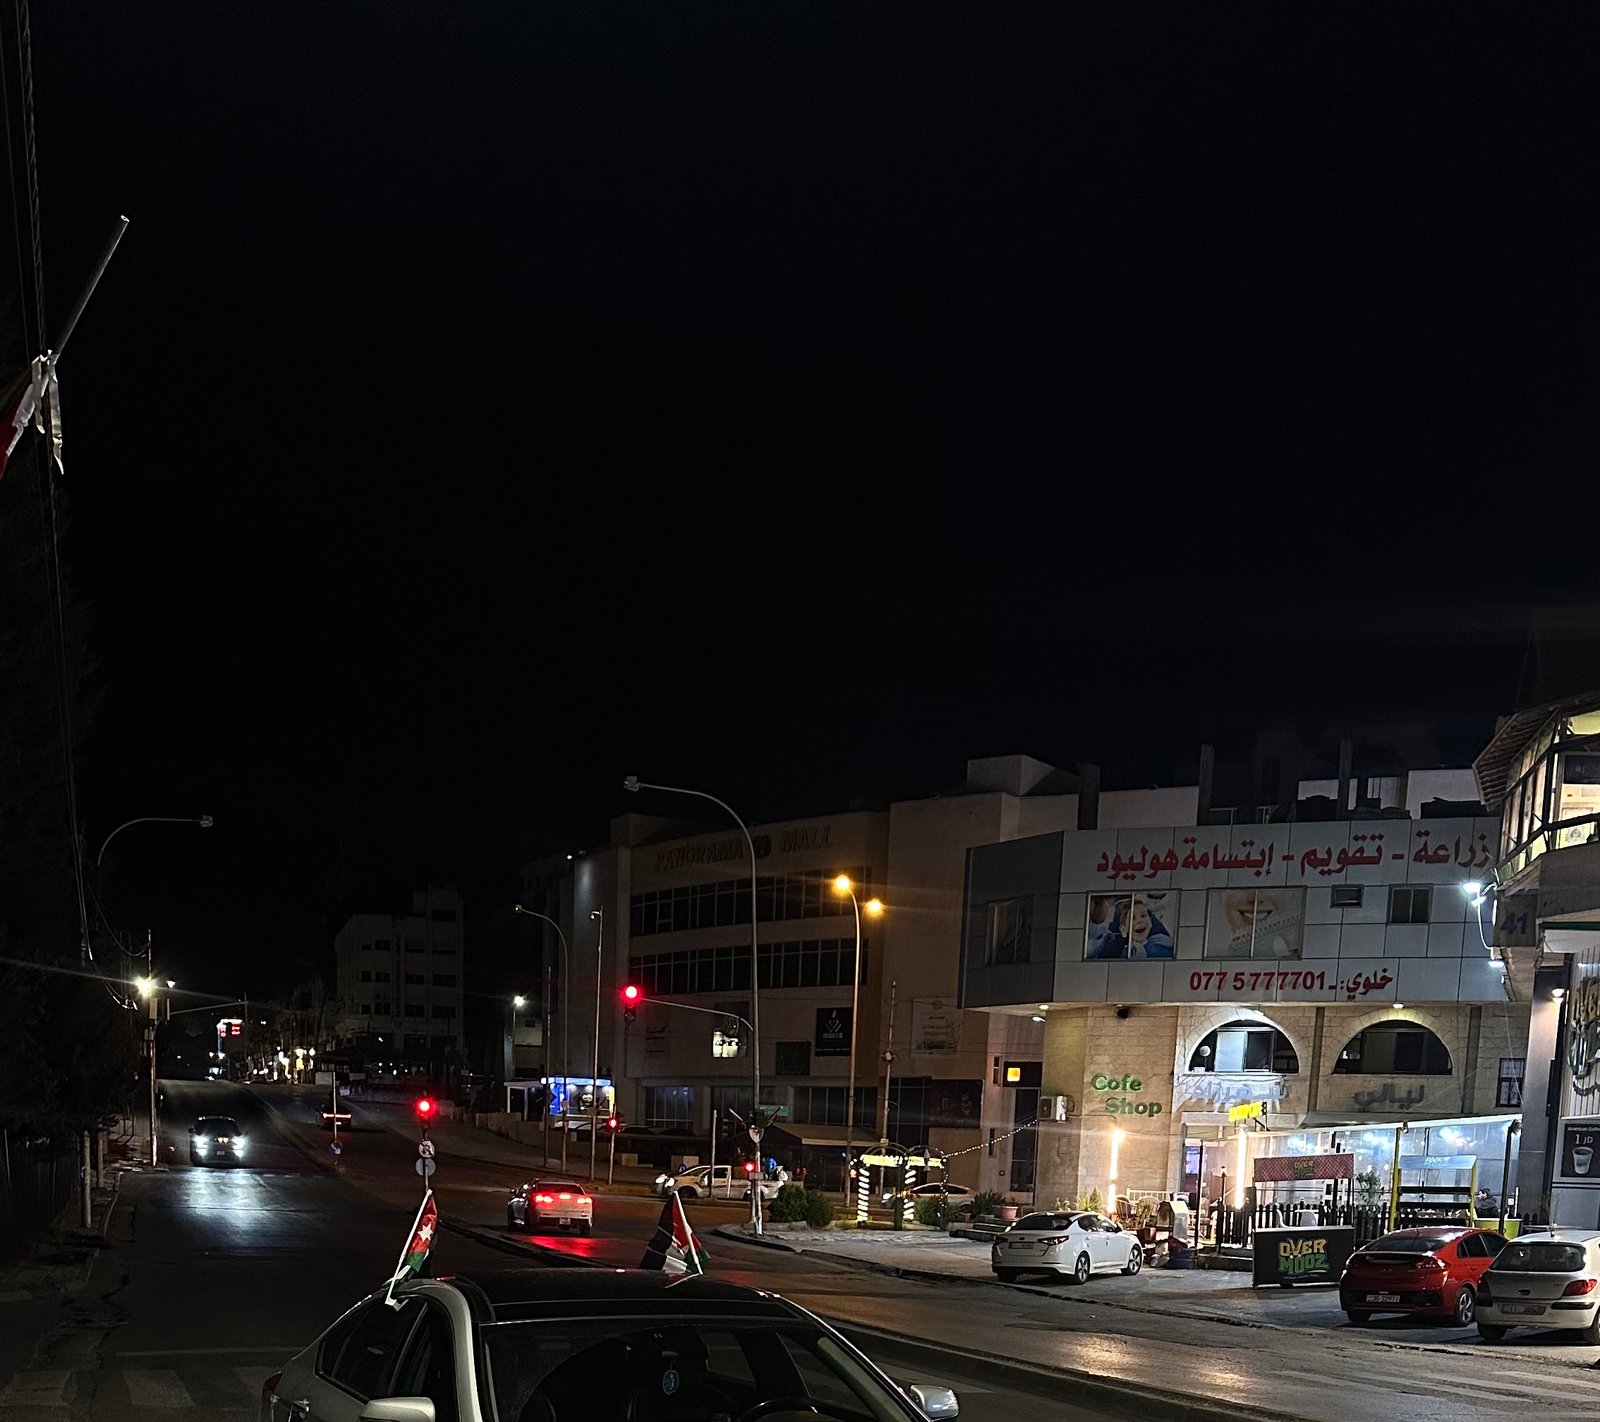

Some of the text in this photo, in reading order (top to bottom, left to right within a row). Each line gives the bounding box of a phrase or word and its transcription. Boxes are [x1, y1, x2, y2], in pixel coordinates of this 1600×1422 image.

[655, 825, 835, 872] PANORAMA MALL
[1097, 845, 1179, 881] هوليود
[1181, 836, 1275, 877] إبتسامة
[1301, 833, 1385, 877] تقويم
[1413, 829, 1490, 868] زراعة
[1500, 912, 1529, 935] 41
[1105, 1097, 1162, 1117] Shop
[1575, 1134, 1581, 1144] 1
[1279, 1238, 1327, 1257] OVER
[1279, 1253, 1330, 1275] MOOZ
